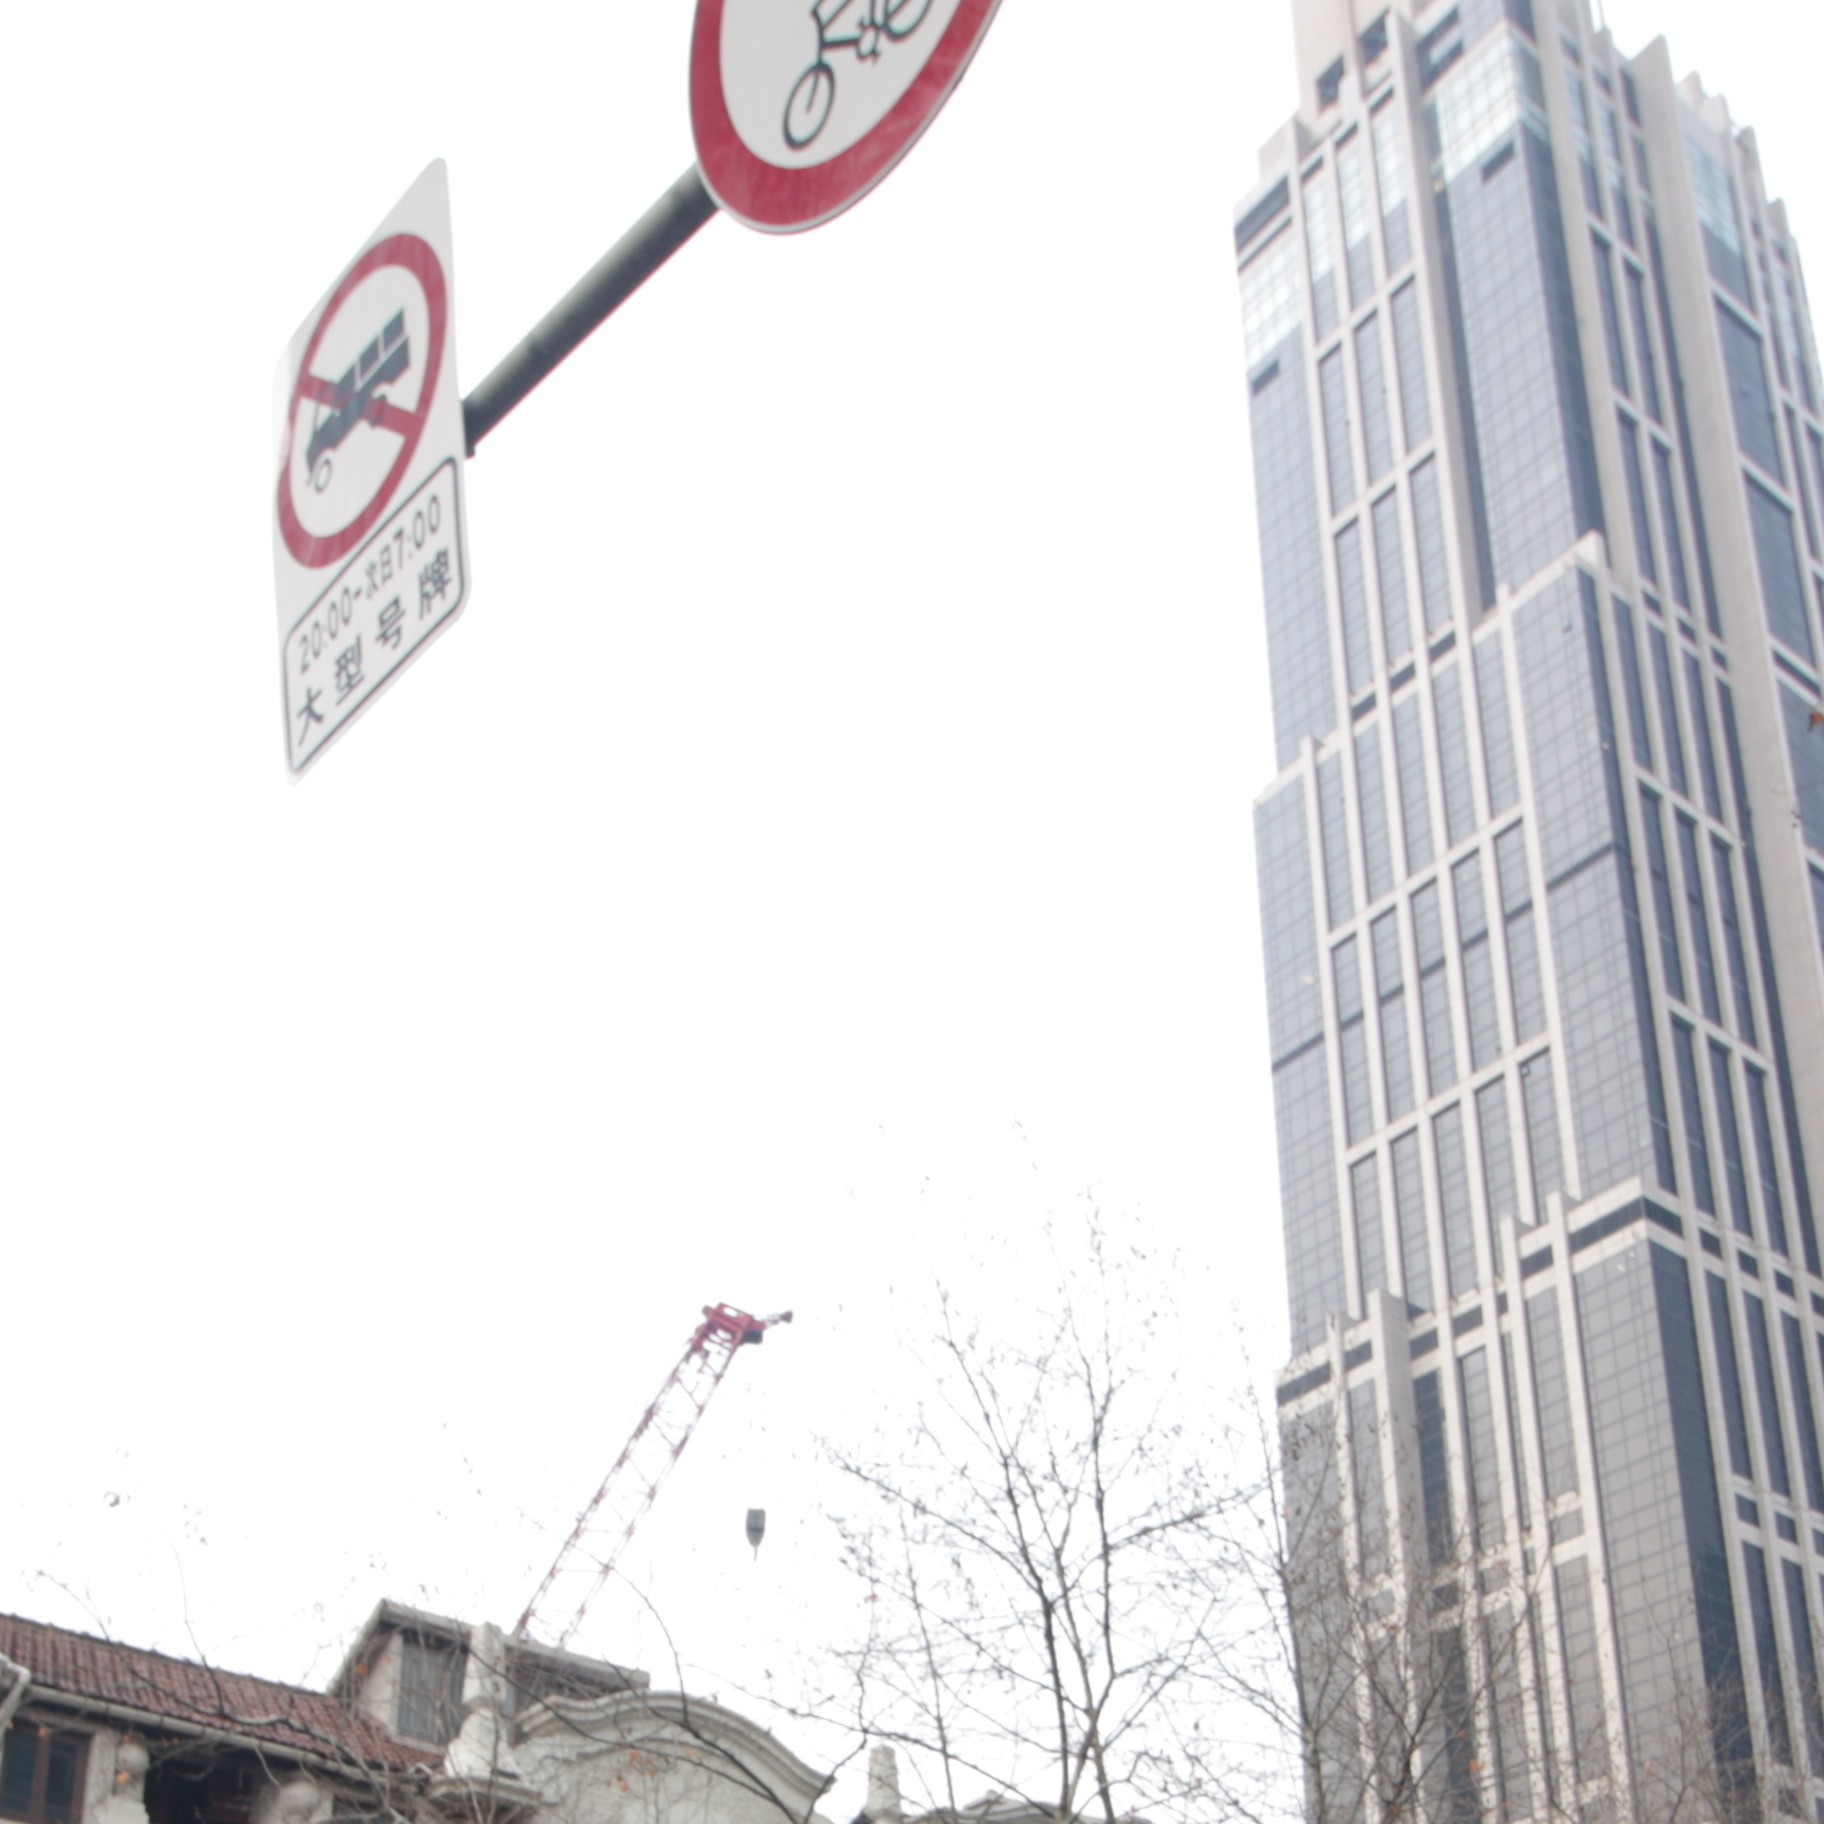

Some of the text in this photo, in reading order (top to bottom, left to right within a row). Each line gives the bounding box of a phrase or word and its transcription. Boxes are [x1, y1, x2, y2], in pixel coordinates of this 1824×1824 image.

[297, 548, 452, 748] 大型号牌
[299, 494, 441, 676] 20:00-次日7:00
